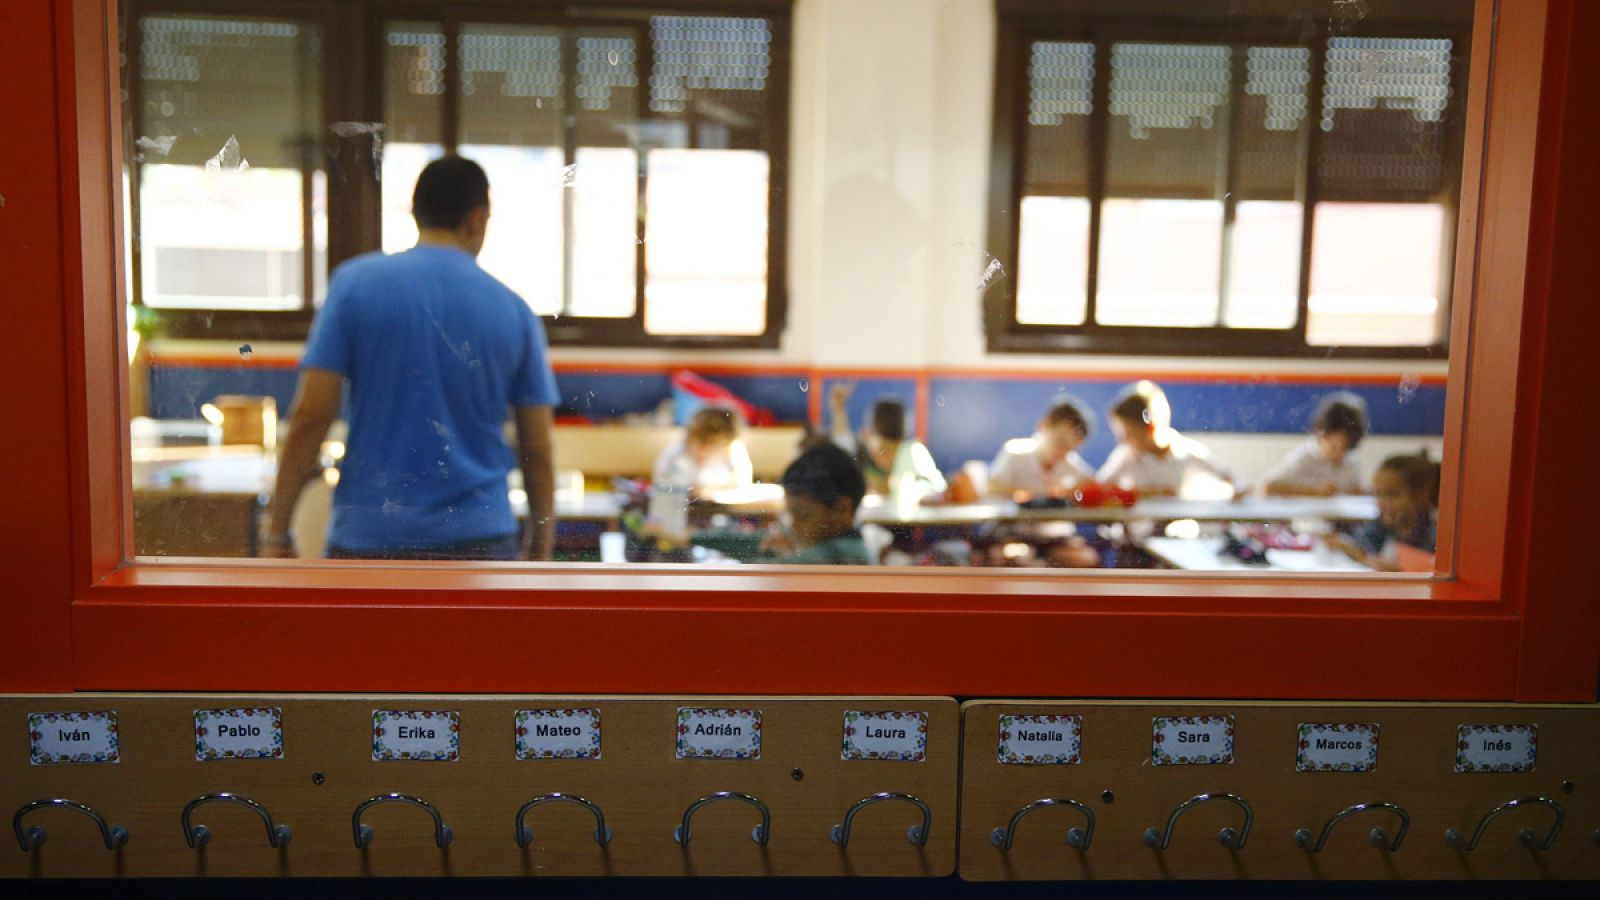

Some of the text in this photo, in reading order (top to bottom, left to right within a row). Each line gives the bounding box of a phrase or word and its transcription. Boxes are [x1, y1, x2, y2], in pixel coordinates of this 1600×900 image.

[58, 728, 91, 743] Iván
[217, 724, 261, 738] Pablo
[398, 725, 436, 740] Erika
[535, 724, 582, 737] Mateo
[693, 723, 742, 738] Adrián
[865, 725, 907, 740] Laura
[1017, 729, 1063, 743] Natalia
[1176, 729, 1211, 744] Sara
[1316, 738, 1362, 752] Marcos
[1483, 738, 1512, 753] Inés
